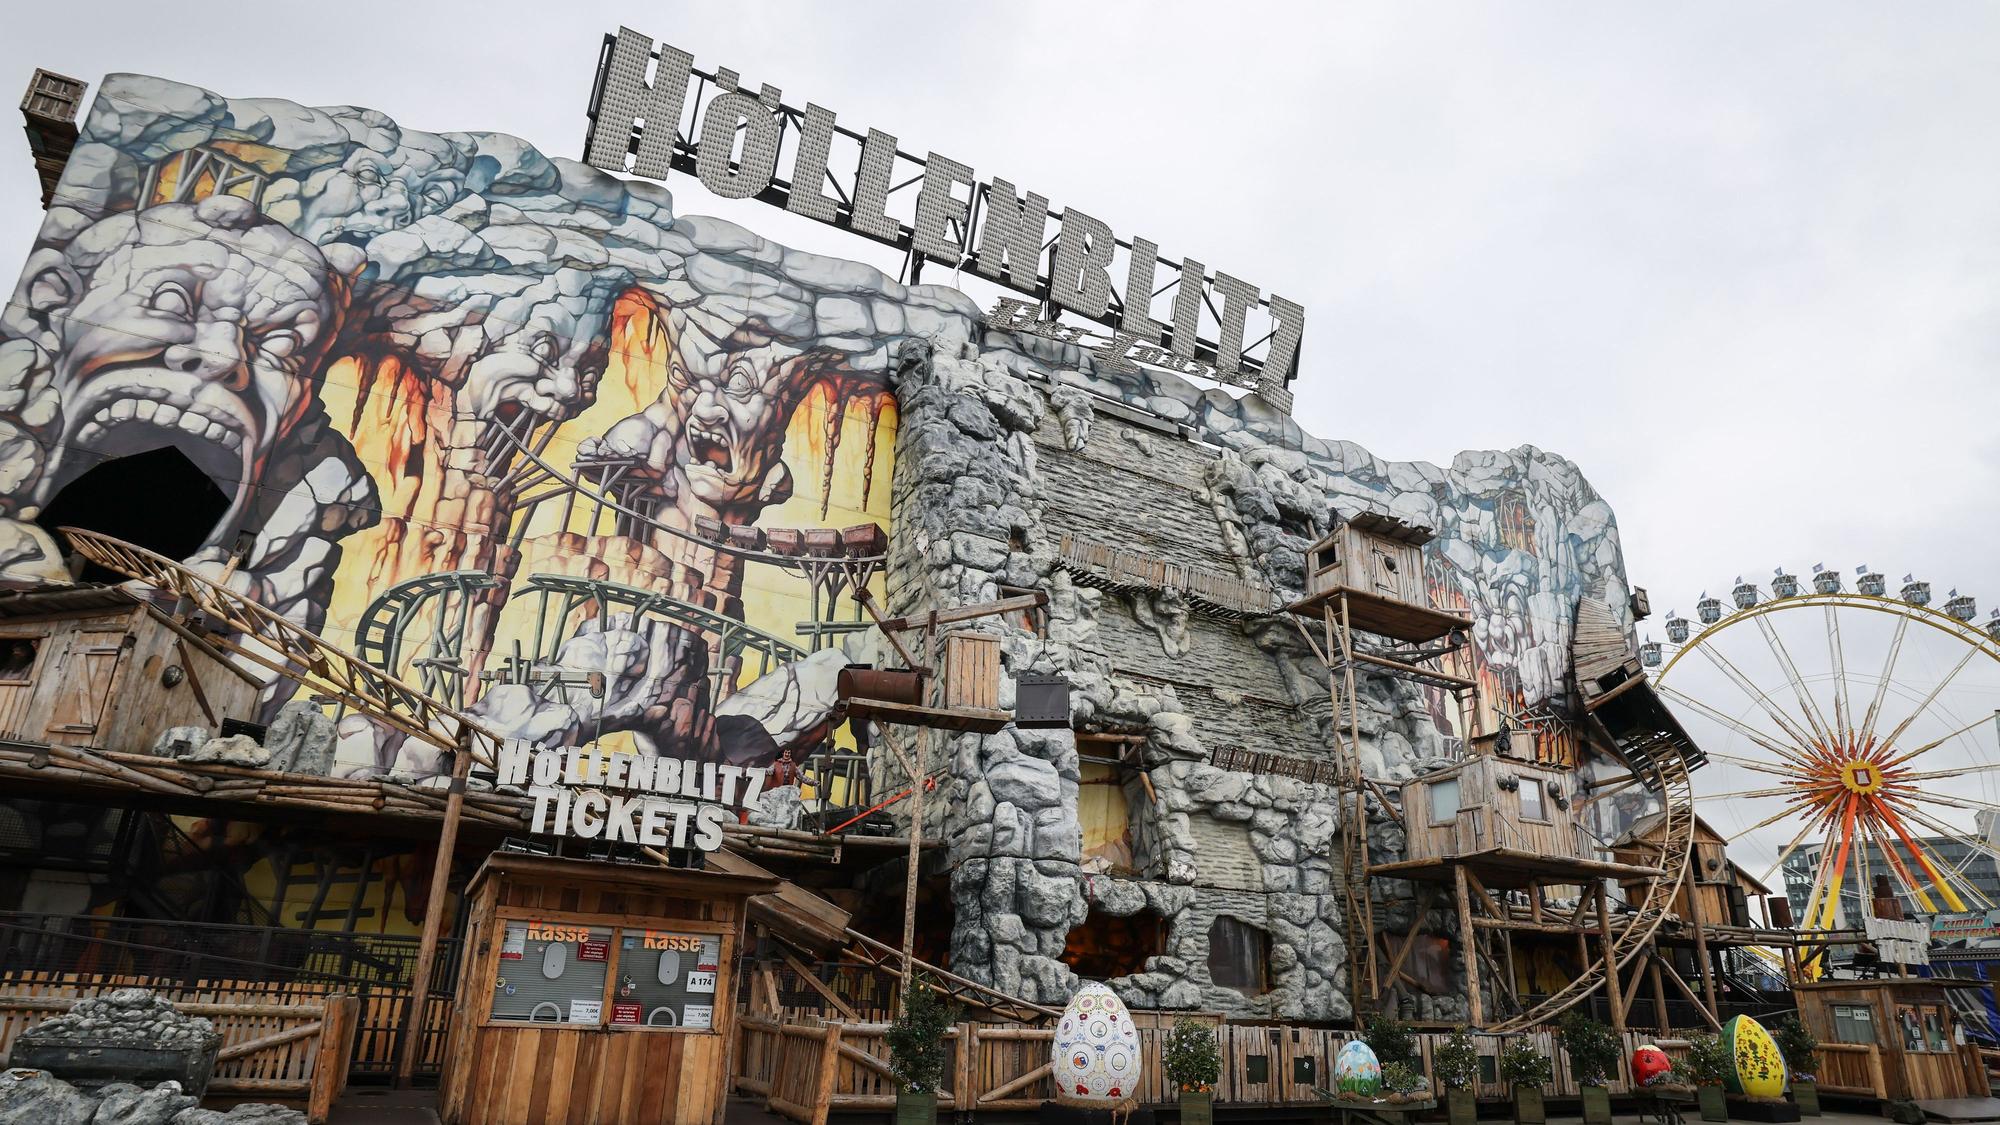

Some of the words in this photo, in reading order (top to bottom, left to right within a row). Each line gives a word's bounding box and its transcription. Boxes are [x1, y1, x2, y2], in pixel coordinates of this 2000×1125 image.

[589, 26, 1305, 416] HÖLLENBLITZ
[498, 738, 767, 812] HÖLLENBLITZ
[528, 785, 724, 851] TICKETS
[527, 920, 591, 943] Kasse
[643, 928, 701, 953] Kasse
[690, 977, 697, 986] A
[698, 978, 713, 986] 174
